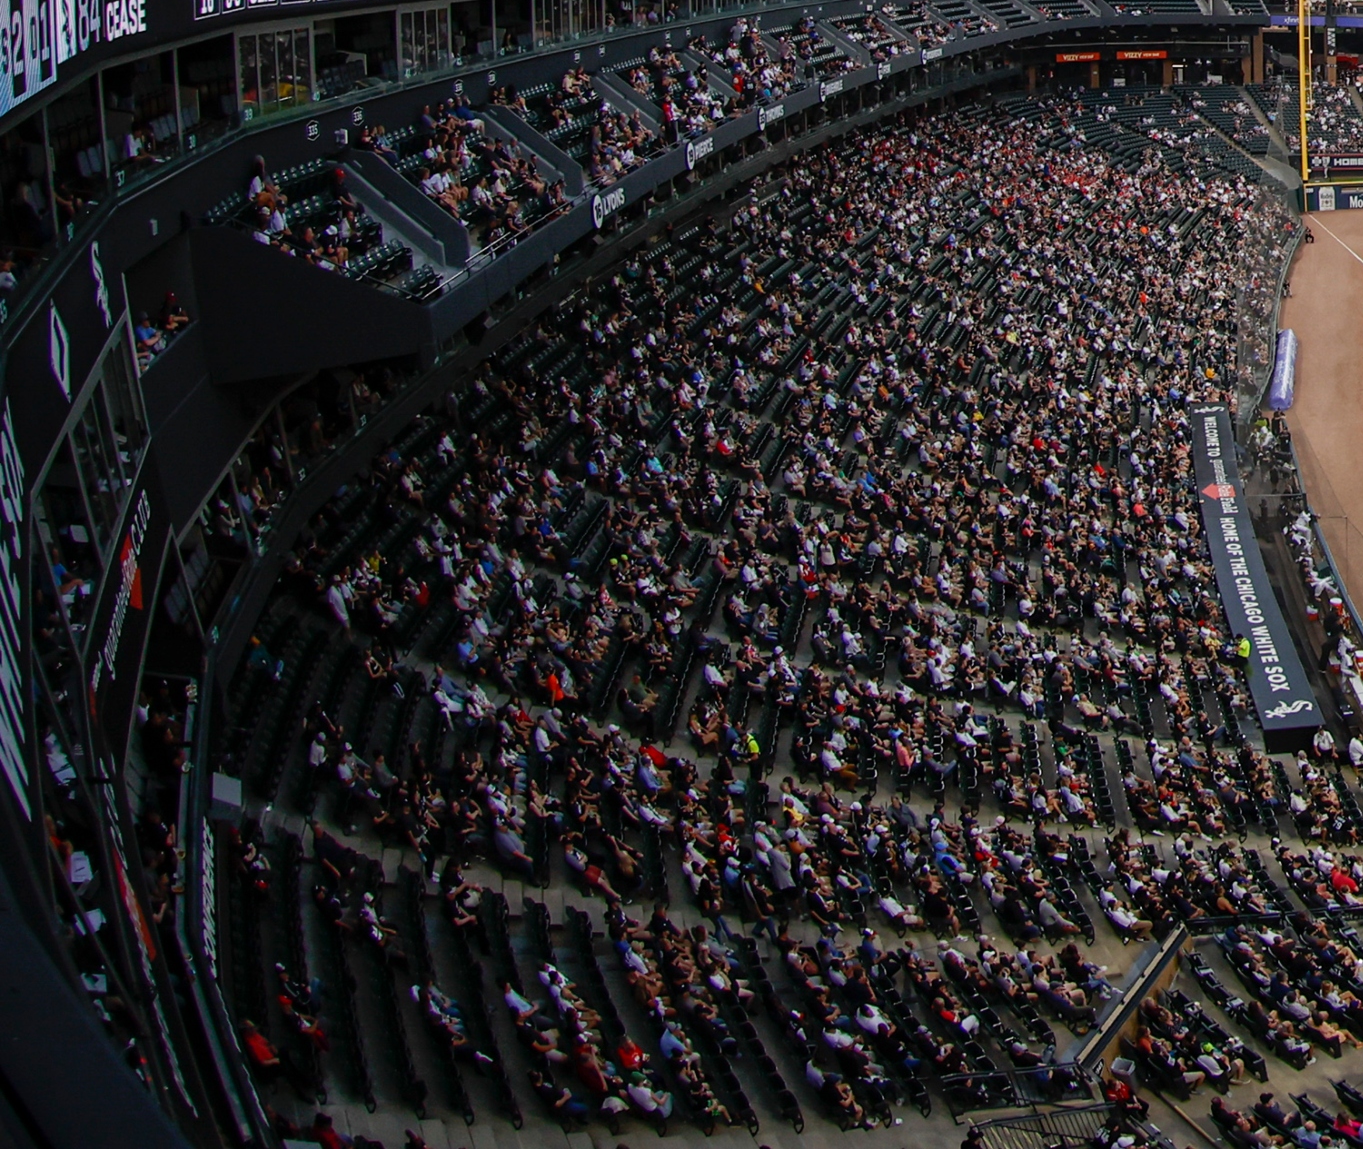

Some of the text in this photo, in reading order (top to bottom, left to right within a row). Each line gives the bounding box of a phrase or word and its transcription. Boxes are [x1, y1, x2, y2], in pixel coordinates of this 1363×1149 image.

[765, 104, 785, 124] THOMAS
[694, 137, 714, 160] PIERCE
[602, 188, 625, 216] LYONS
[130, 488, 151, 556] CLUB
[1203, 416, 1291, 692] WELCOME TO Field HOME OF THE CHICAGO WHITE SOX
